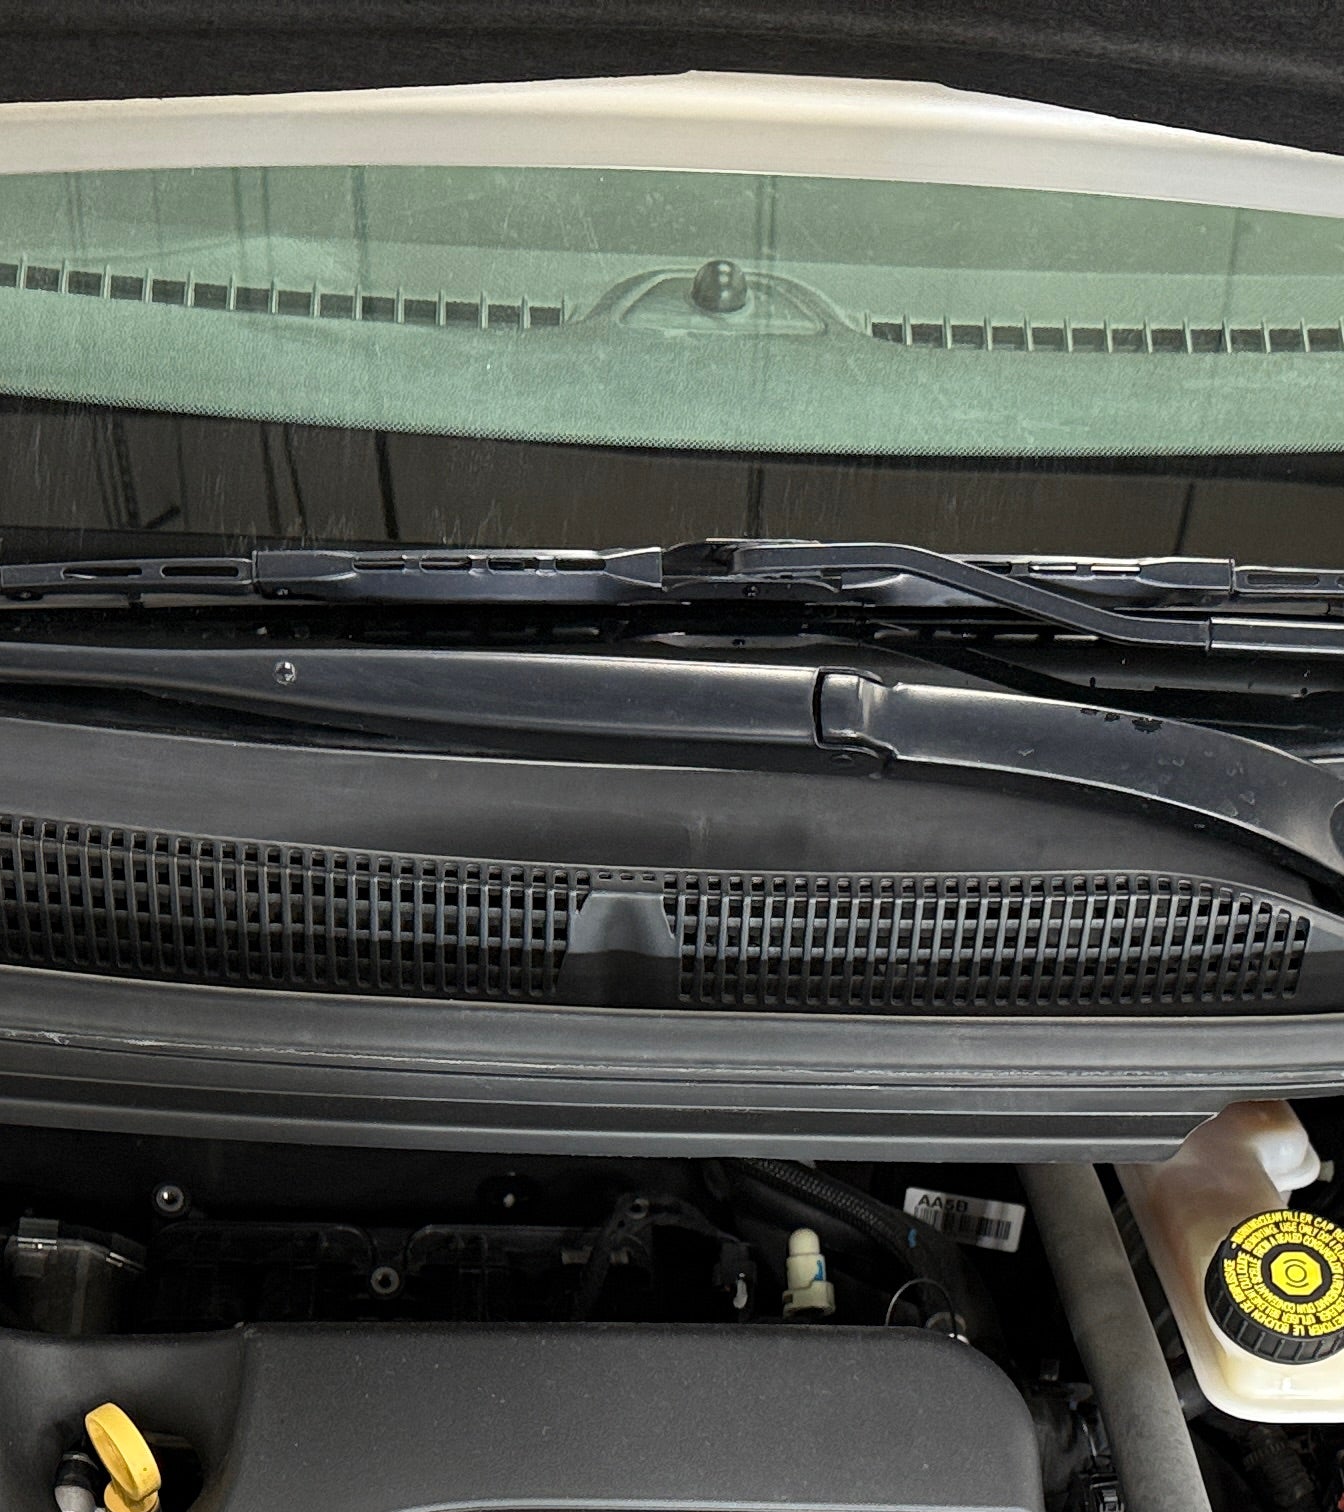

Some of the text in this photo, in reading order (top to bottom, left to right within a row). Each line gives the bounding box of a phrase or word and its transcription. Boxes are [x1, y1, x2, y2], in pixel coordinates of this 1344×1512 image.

[1278, 1221, 1297, 1233] USE
[1281, 1210, 1313, 1224] FILLER
[1312, 1214, 1337, 1233] CAP
